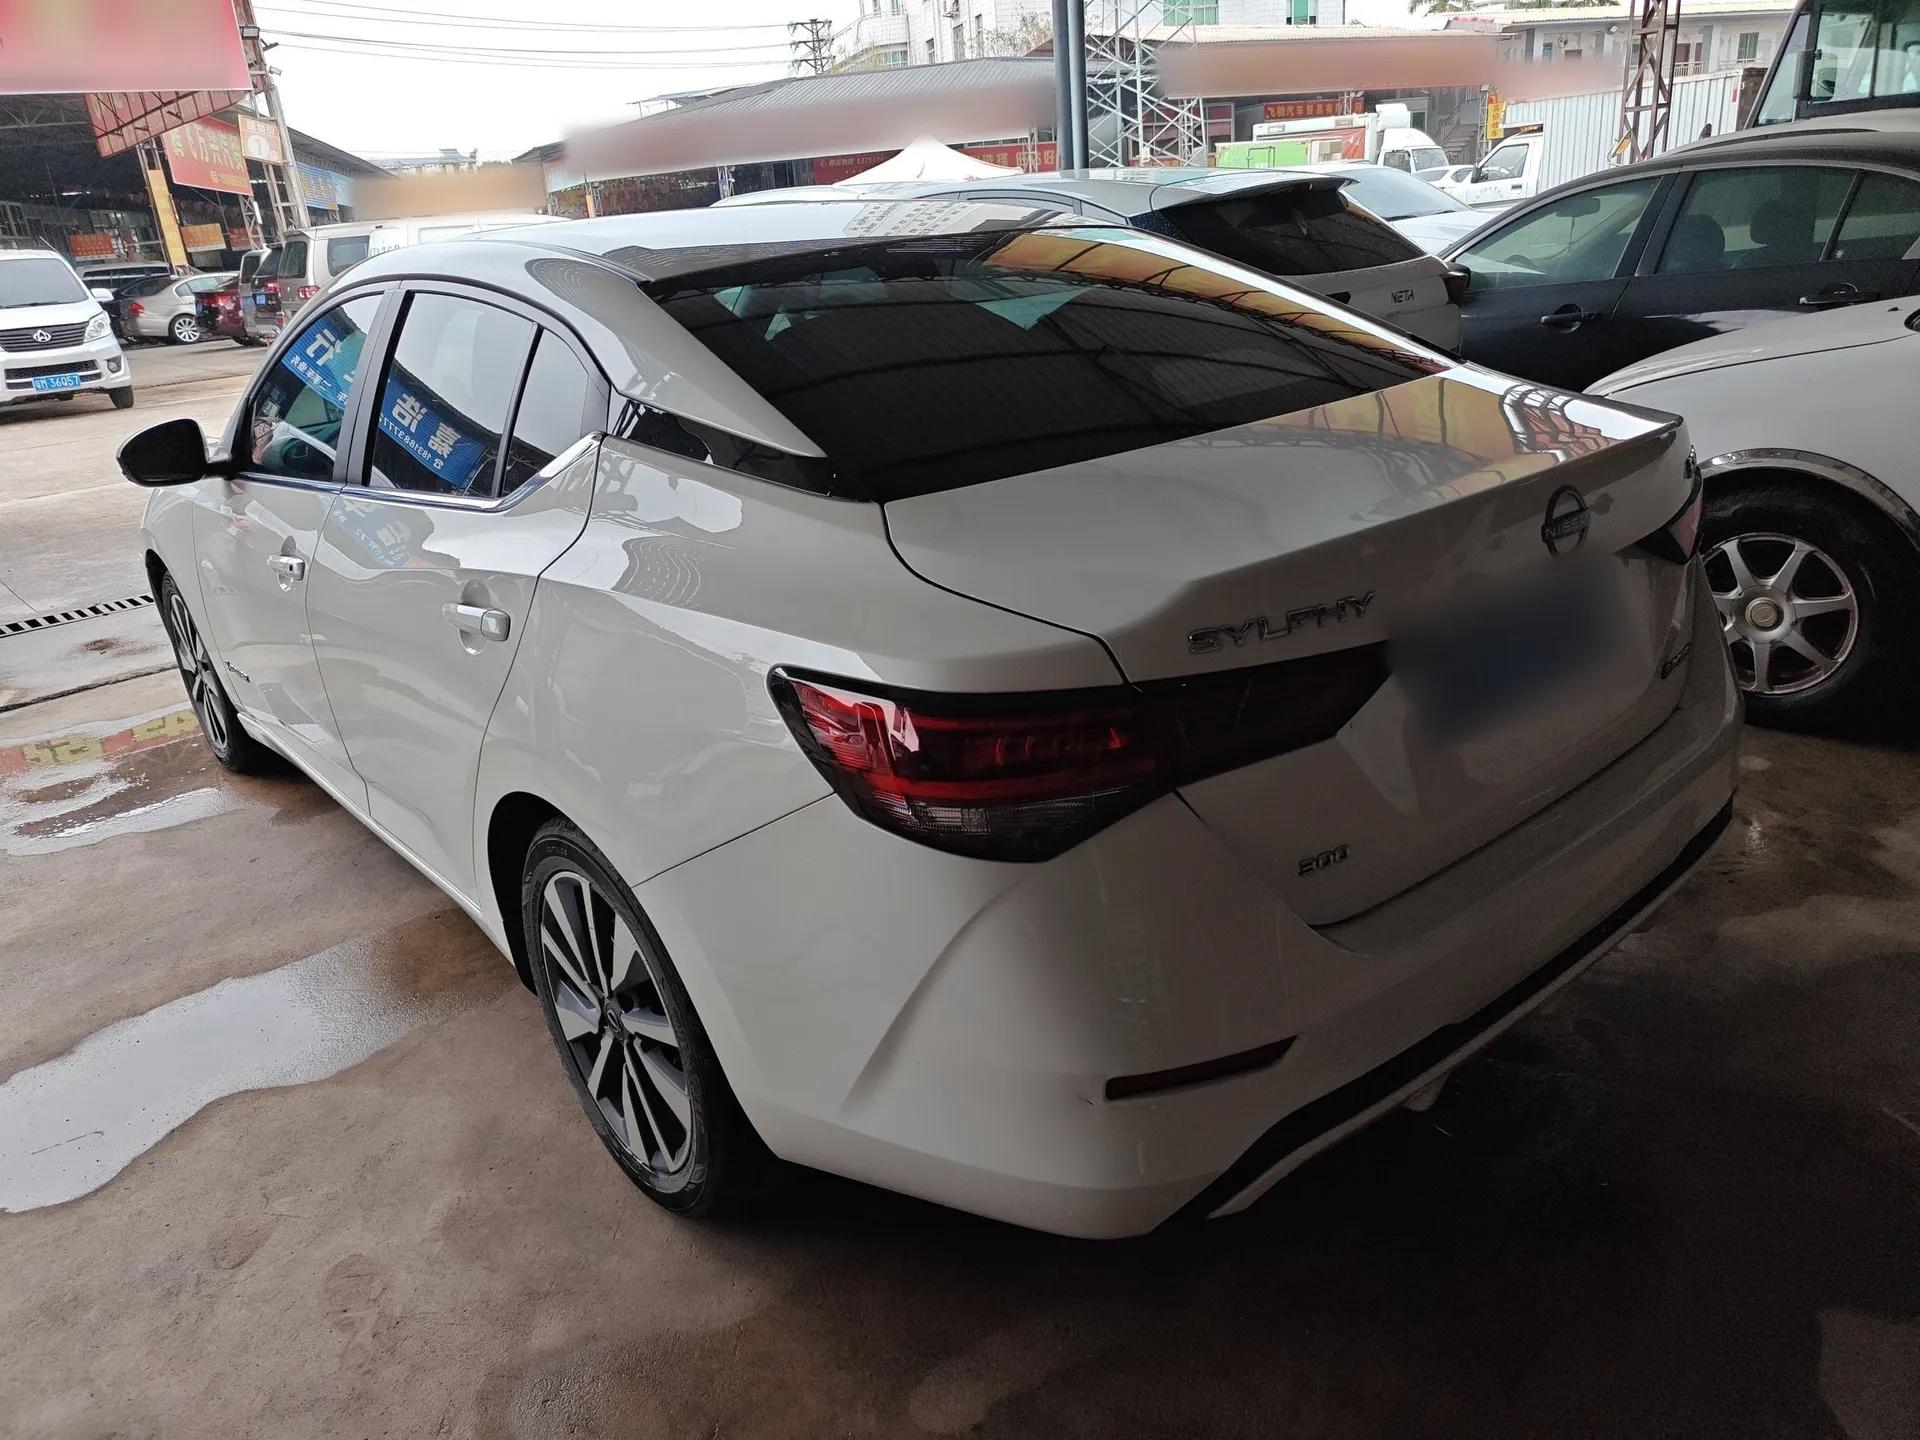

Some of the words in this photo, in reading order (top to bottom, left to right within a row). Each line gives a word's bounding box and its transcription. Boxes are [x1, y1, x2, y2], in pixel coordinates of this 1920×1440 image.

[1267, 101, 1361, 118] 飞驰汽车贸易有限司
[1391, 289, 1415, 304] NETA
[1187, 590, 1377, 655] SYLPHY
